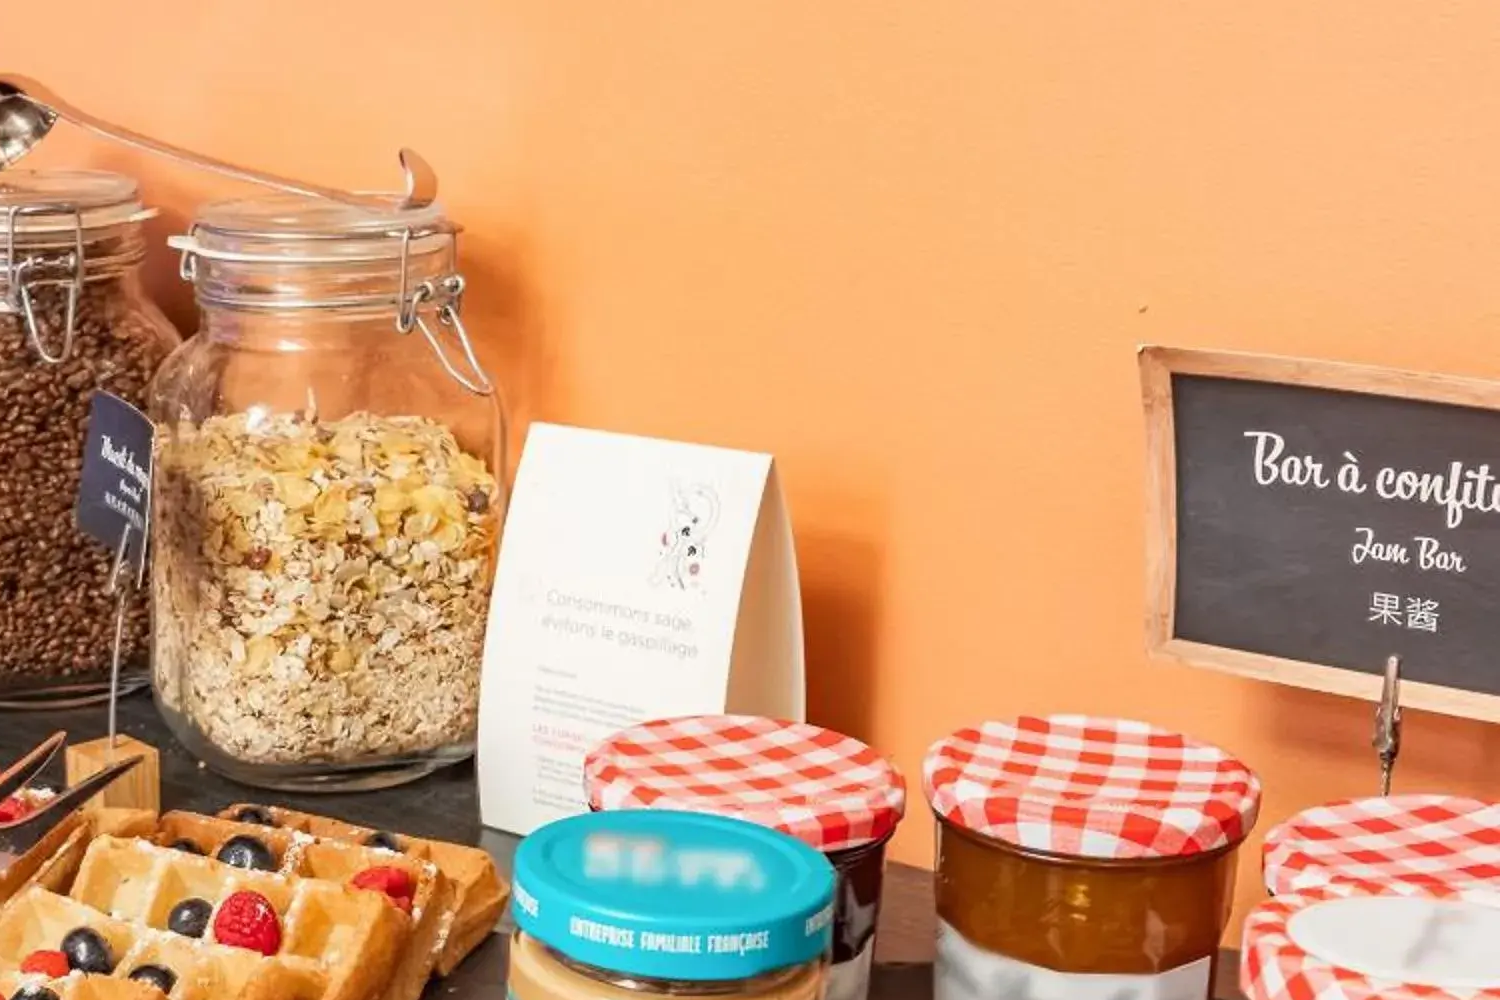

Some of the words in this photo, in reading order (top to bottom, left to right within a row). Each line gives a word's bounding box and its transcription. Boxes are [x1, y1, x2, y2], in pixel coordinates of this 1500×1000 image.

[1243, 431, 1329, 489] Bar
[1337, 451, 1367, 494] à
[1352, 527, 1410, 565] Jam
[1413, 536, 1467, 573] Bar
[1368, 591, 1440, 633] 果酱
[570, 915, 635, 949] ENTREPRISE
[640, 931, 702, 954] FAMILIALE
